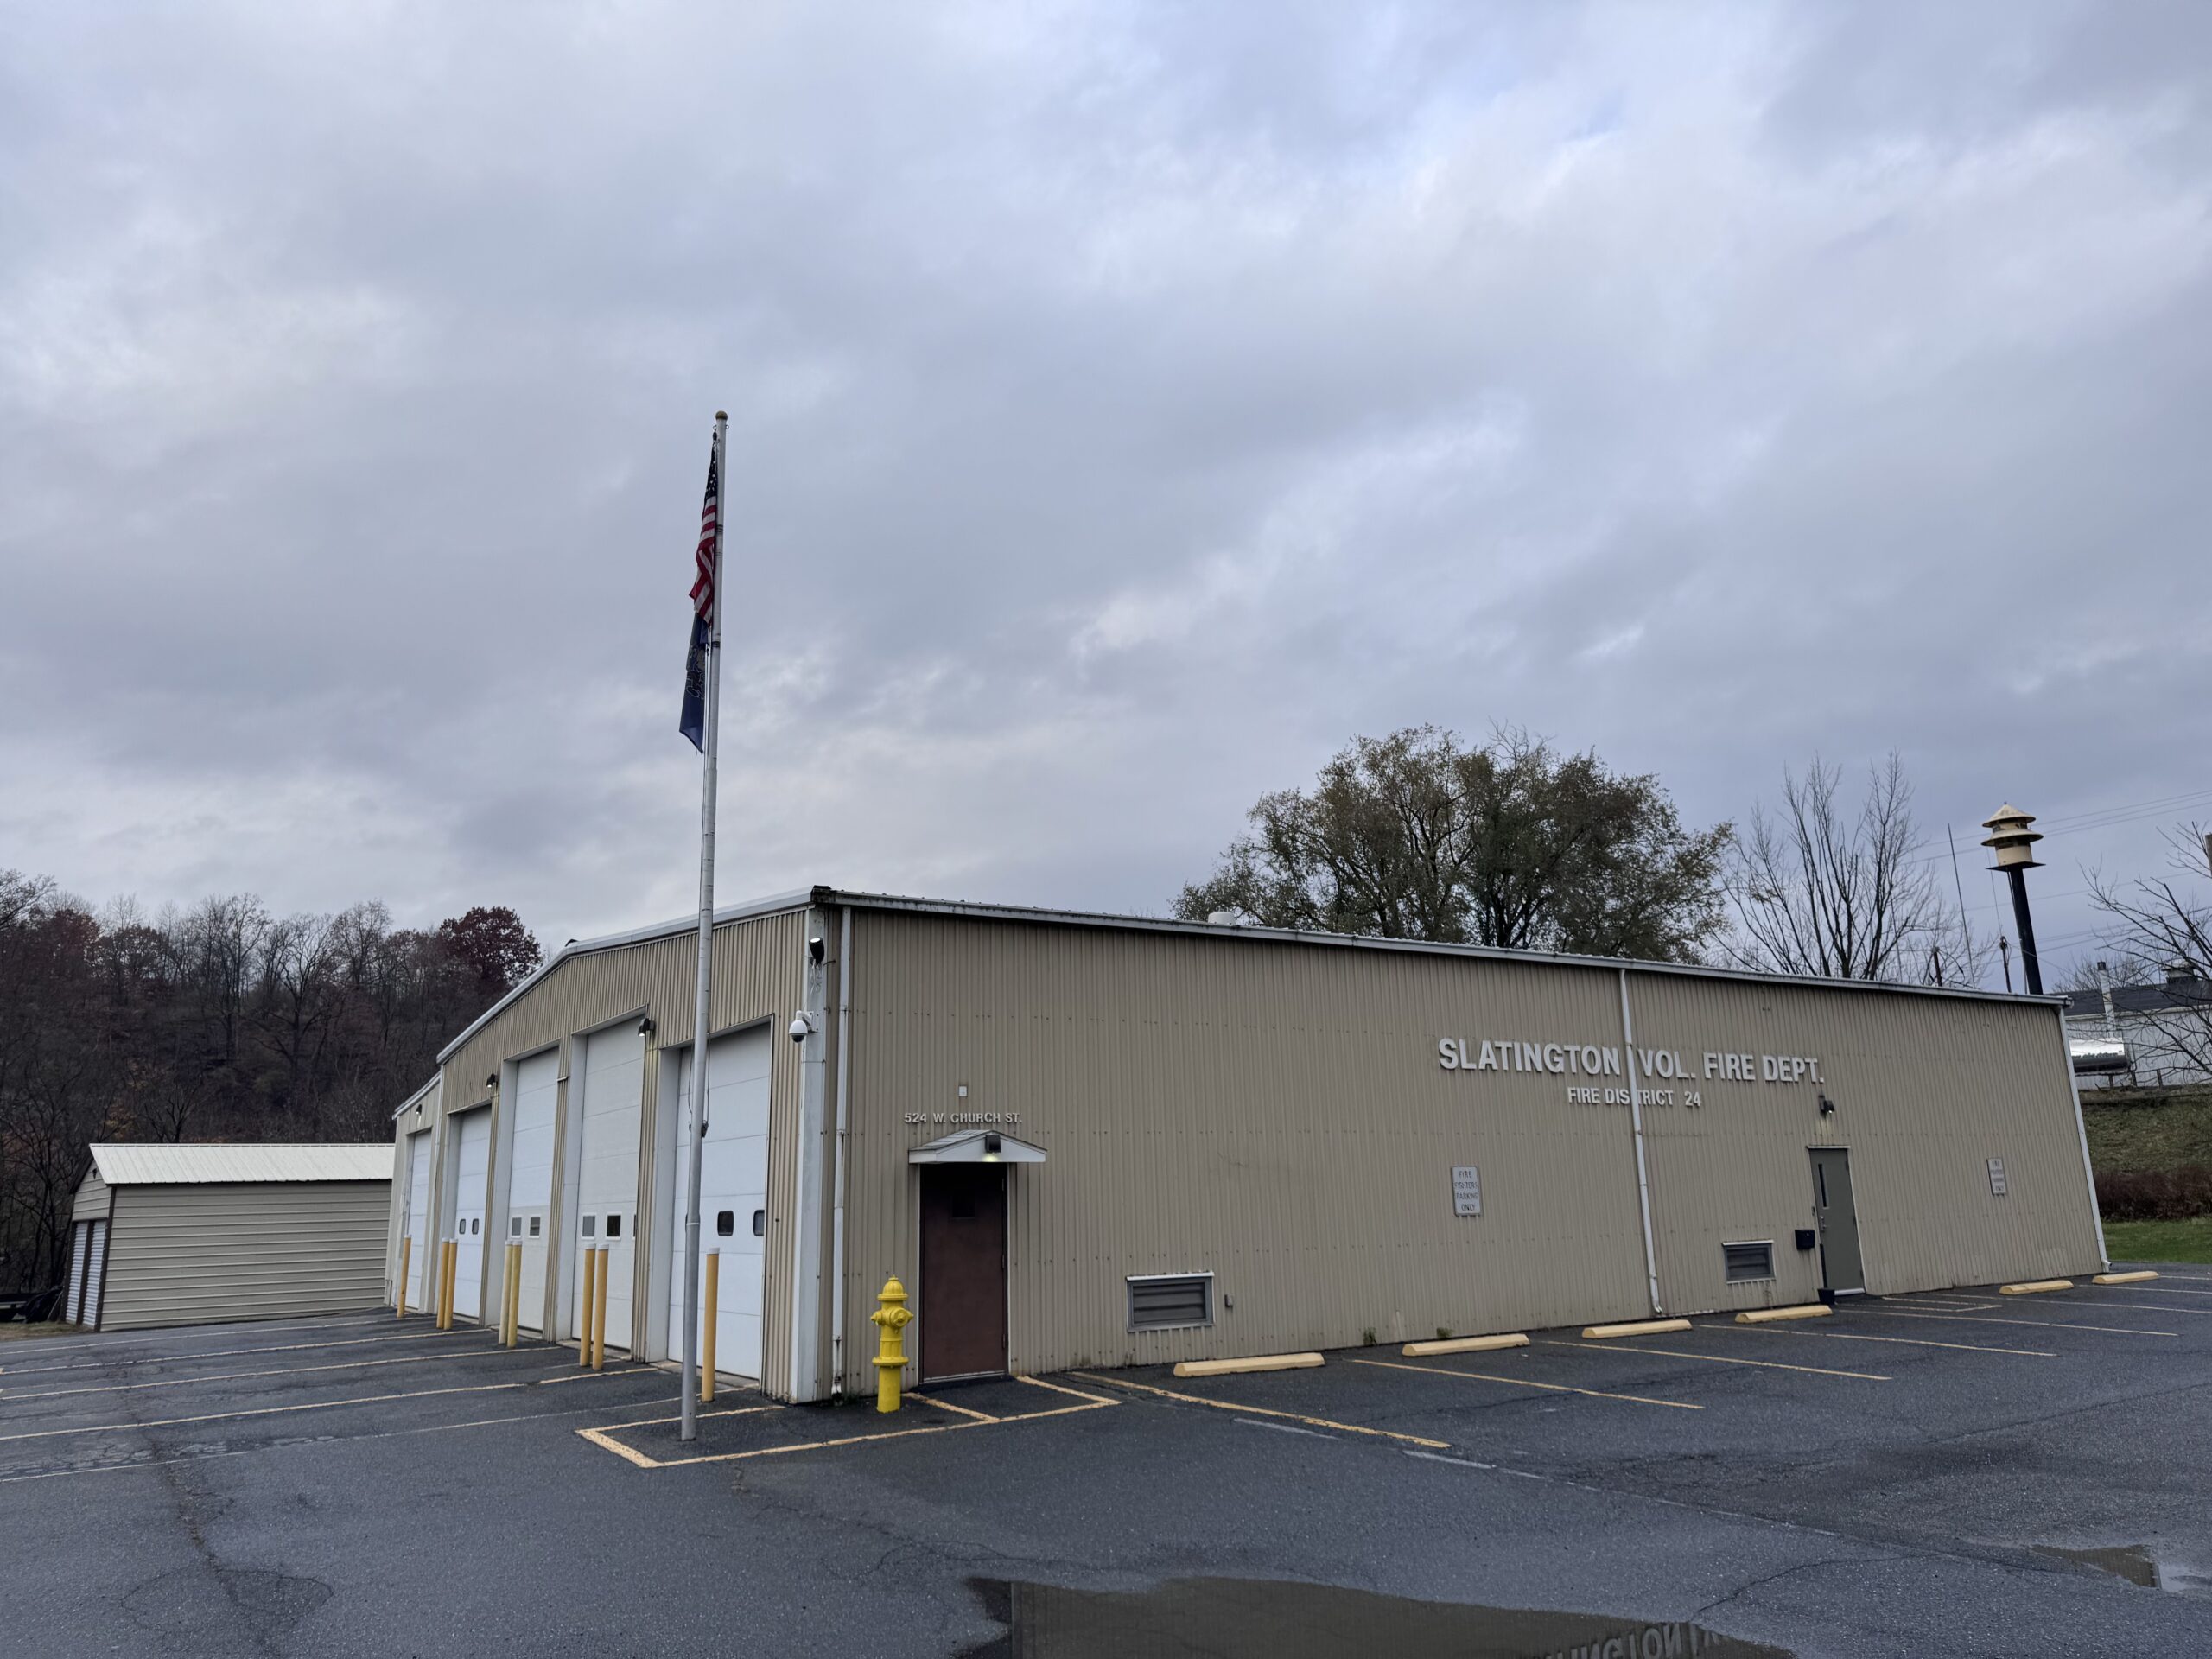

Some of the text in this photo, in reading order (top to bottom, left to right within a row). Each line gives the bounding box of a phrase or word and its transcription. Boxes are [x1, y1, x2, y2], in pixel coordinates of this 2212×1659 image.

[1438, 1038, 1825, 1084] SLATINGTON VOL. FIRE DEPT.
[1567, 1086, 1600, 1104] FIRE
[1684, 1090, 1701, 1107] 24
[904, 1112, 1023, 1123] 524 W. CHURCH ST.
[1459, 1170, 1472, 1179] FIRE
